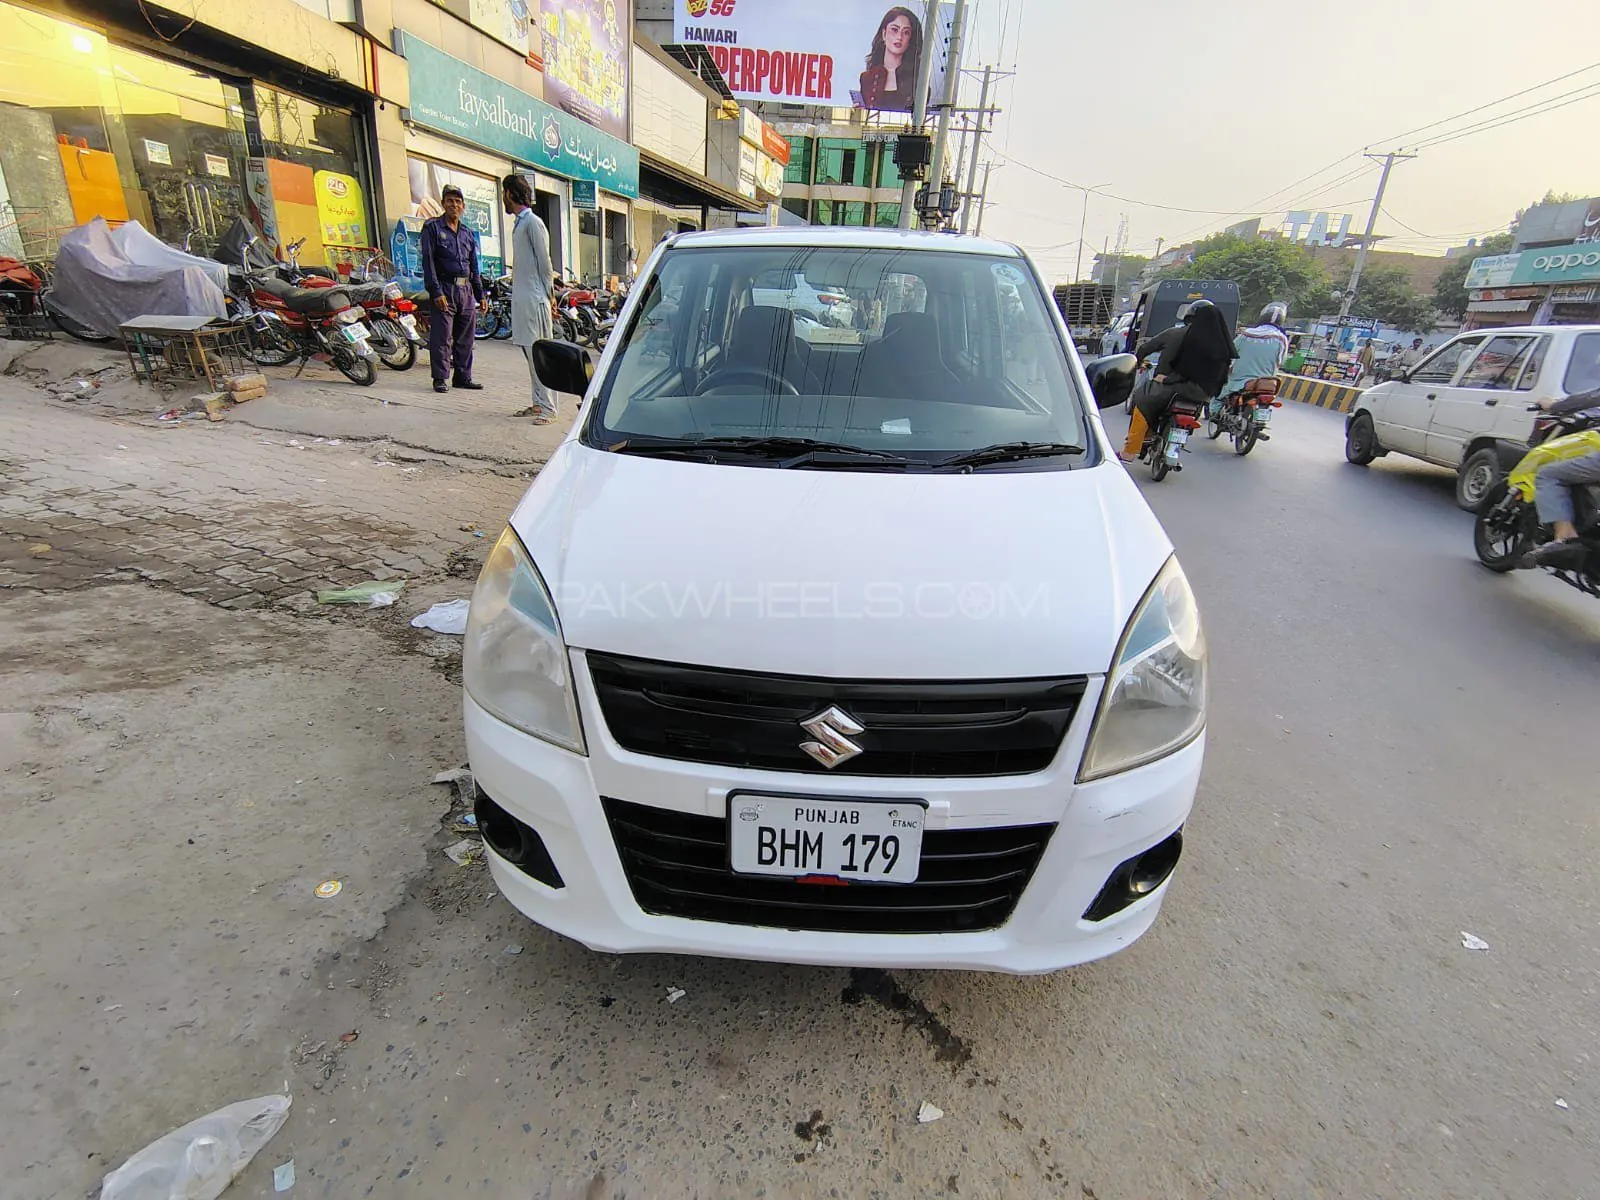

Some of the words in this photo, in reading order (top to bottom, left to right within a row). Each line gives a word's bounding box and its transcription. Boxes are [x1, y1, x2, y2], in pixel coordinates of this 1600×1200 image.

[710, 0, 736, 16] 5G
[684, 27, 738, 44] HAMARI
[707, 45, 834, 99] PERPOWER
[457, 78, 538, 141] faysalbank
[1285, 210, 1353, 248] TAJ
[1532, 251, 1600, 273] oppo
[1165, 281, 1234, 290] SAZGAR
[794, 807, 860, 825] PUNJAB
[891, 819, 918, 829] ET&NC
[757, 826, 824, 870] BHM
[840, 833, 900, 874] 179
